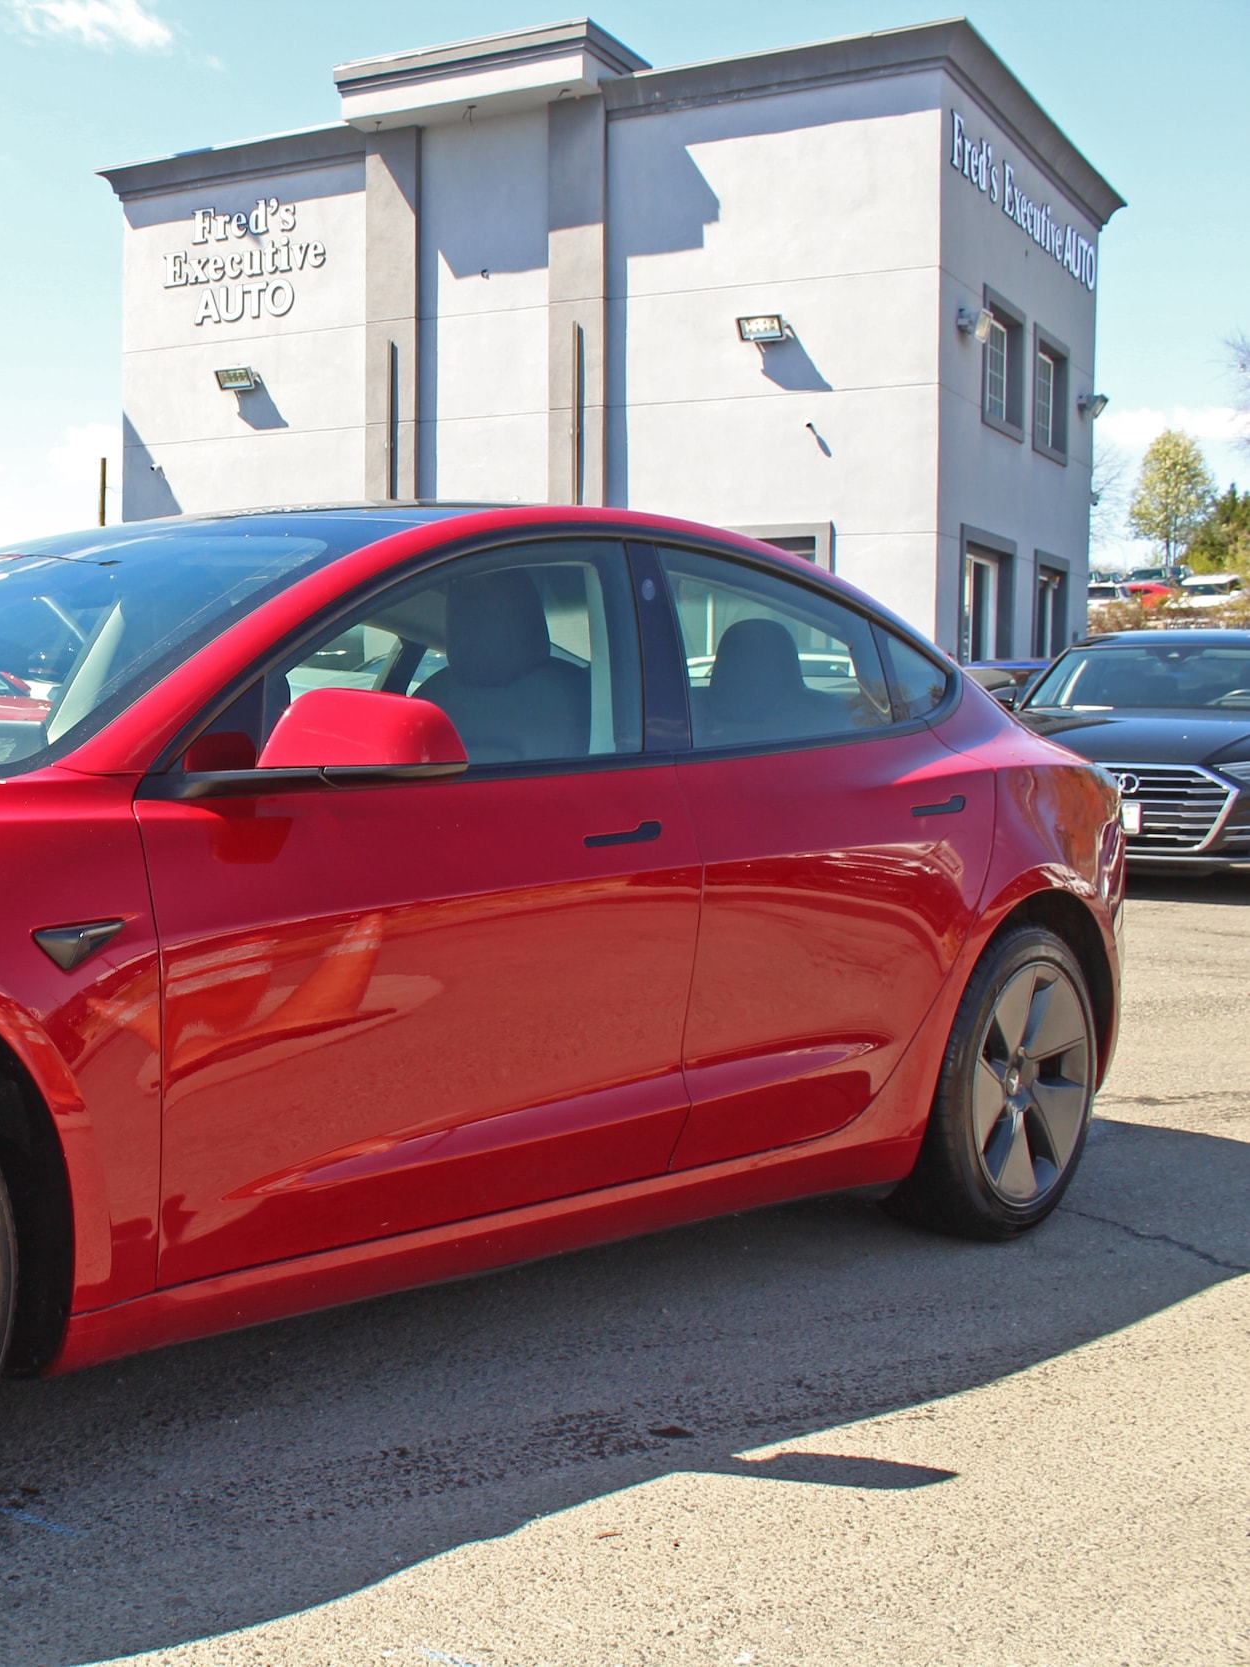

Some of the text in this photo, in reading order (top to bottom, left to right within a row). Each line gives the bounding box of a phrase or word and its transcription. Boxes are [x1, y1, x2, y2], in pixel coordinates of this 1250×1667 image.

[191, 197, 296, 245] Fred's
[951, 109, 1096, 291] Fred's Executive AUTO
[163, 237, 326, 288] Executive
[194, 279, 295, 325] AUTO
